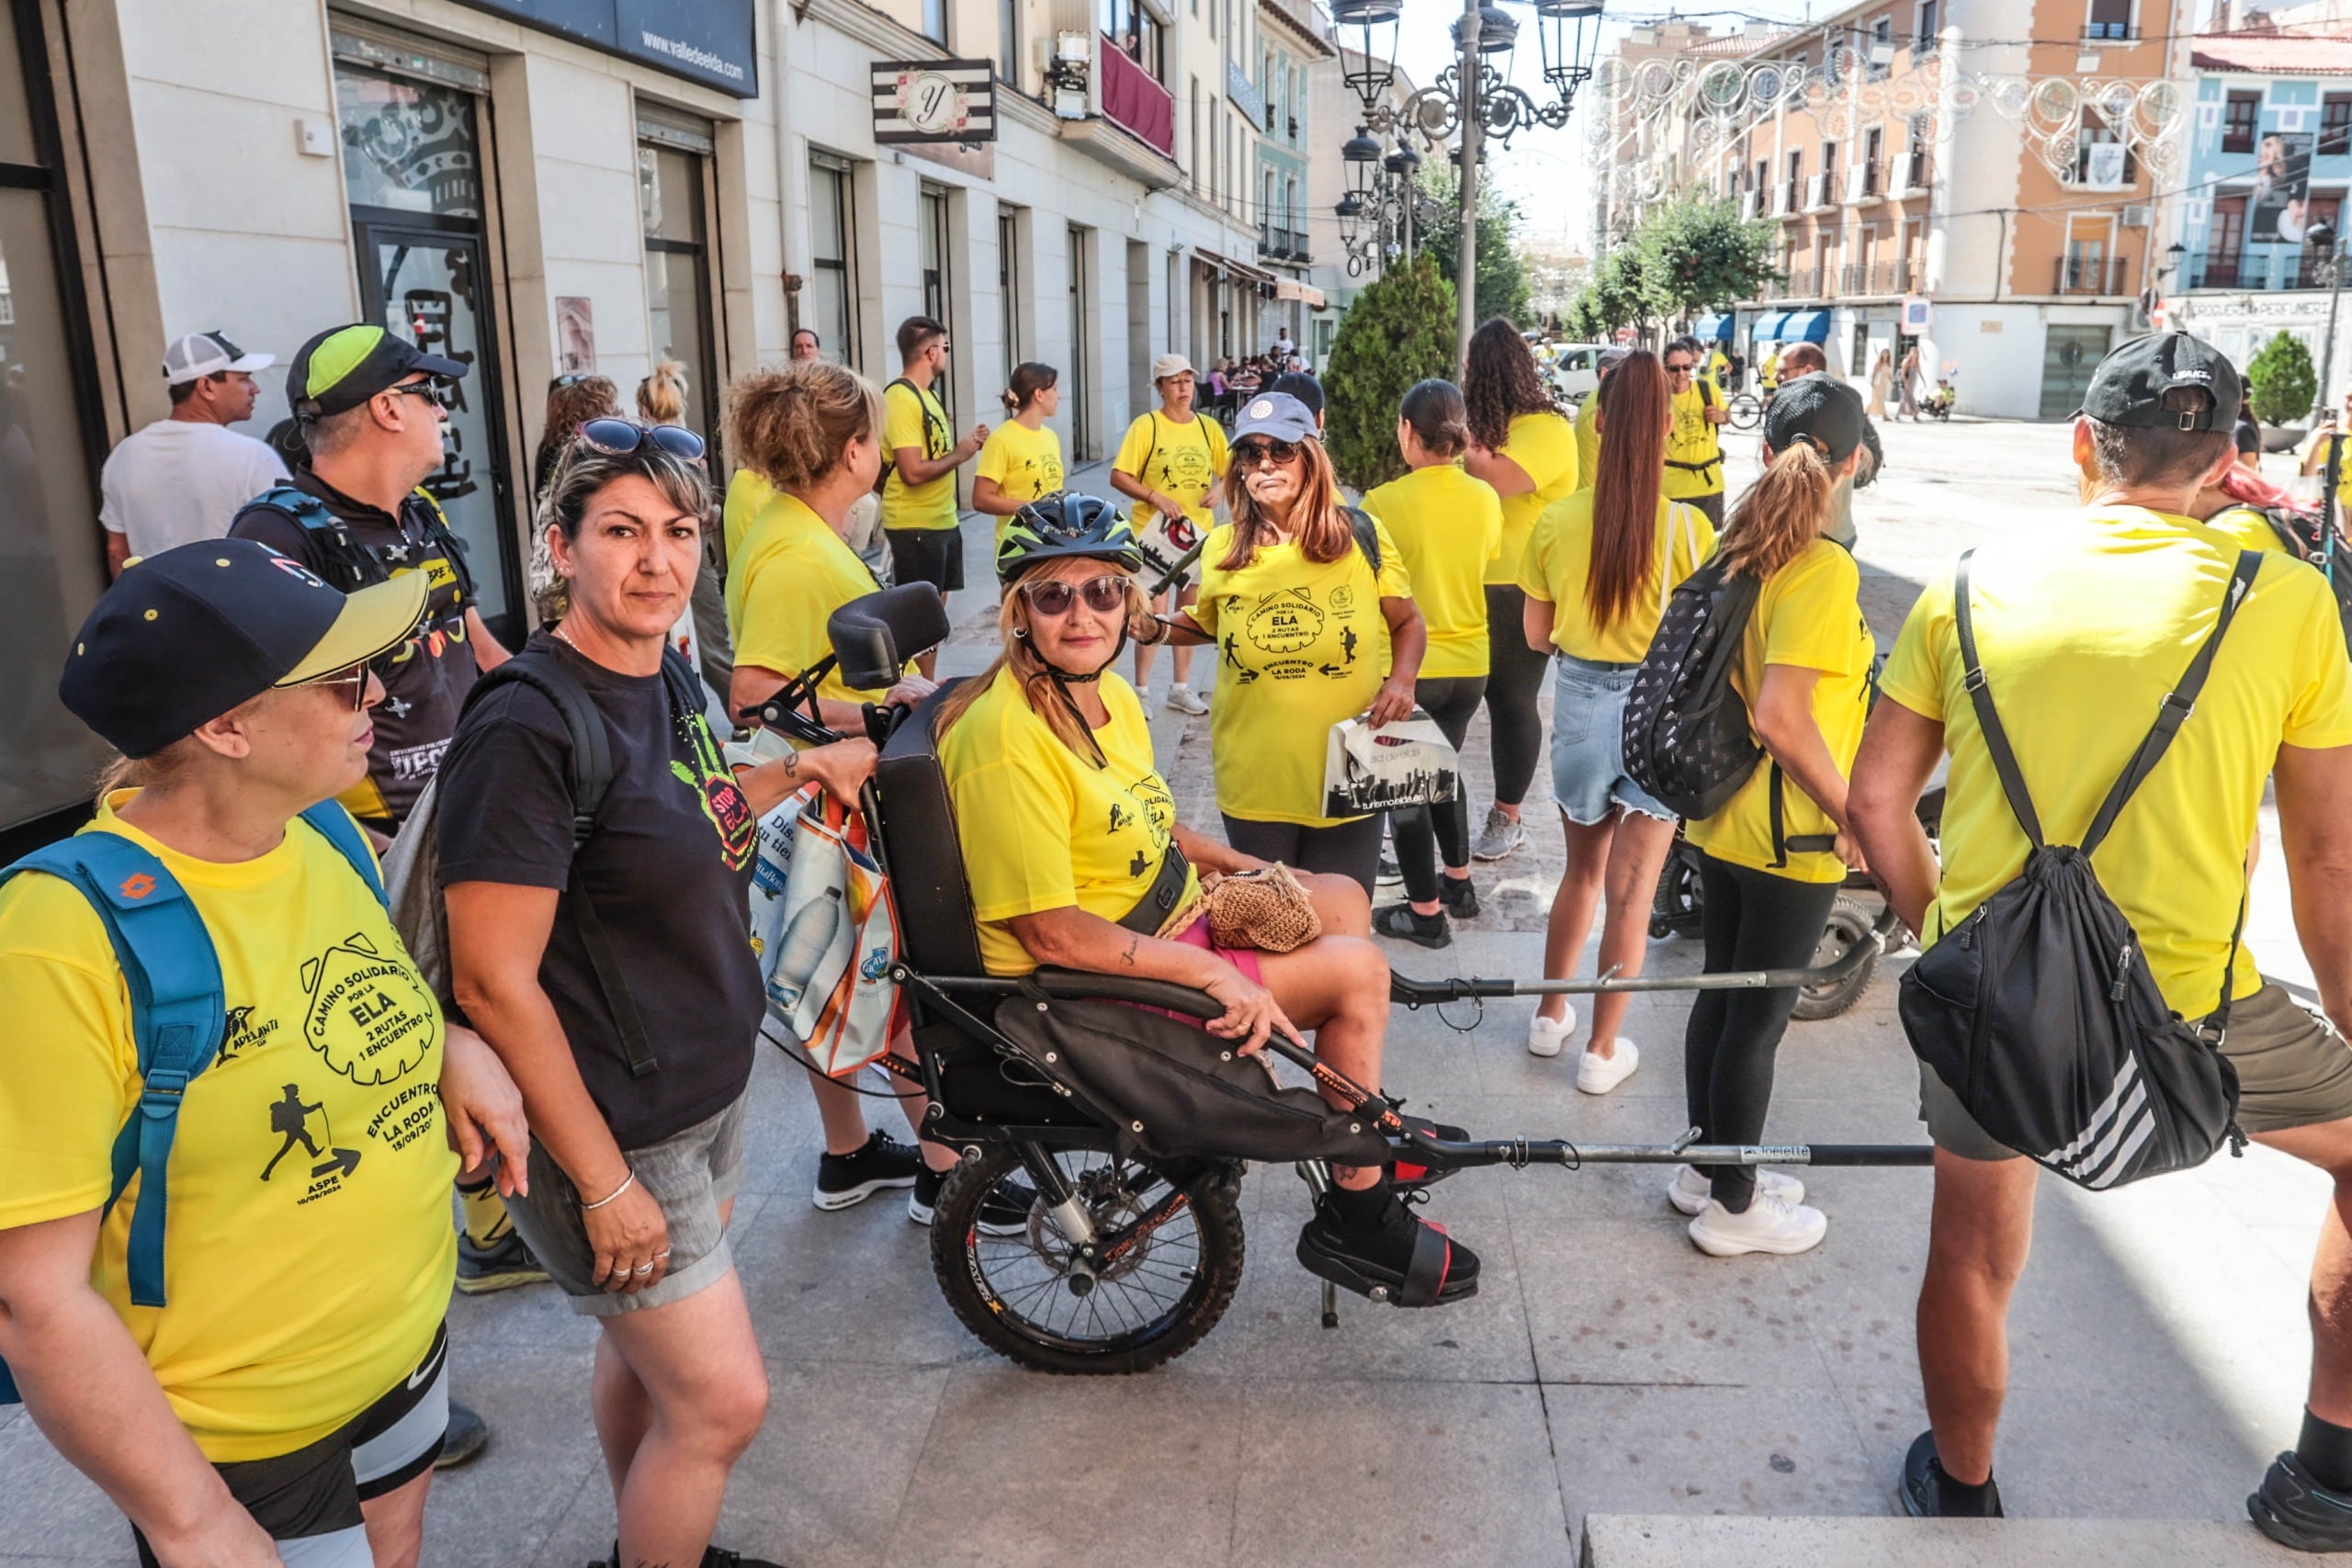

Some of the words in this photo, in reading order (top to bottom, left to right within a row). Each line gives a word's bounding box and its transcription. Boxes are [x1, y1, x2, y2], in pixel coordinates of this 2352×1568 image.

[642, 30, 743, 81] www.valledeelda.com
[1251, 604, 1279, 622] CAMINO
[1281, 603, 1321, 617] SOLIDARIO
[1272, 615, 1298, 626] ELA
[1267, 631, 1309, 639] ENCUENTRO
[1262, 659, 1315, 671] ENCUENTRO
[711, 786, 737, 814] STOP
[1362, 793, 1425, 810] turismo.elda.es
[723, 802, 748, 831] ELA
[313, 984, 345, 1037] CAMINO
[345, 965, 410, 987] SOLIDARIO
[347, 991, 365, 1003] POR
[363, 984, 375, 994] LA
[349, 992, 397, 1027] ELA
[358, 1052, 366, 1061] 1
[366, 1014, 424, 1057] ENCUENTRO
[366, 1032, 375, 1042] 2
[374, 1010, 408, 1036] RUTAS
[367, 1083, 439, 1138] ENCUENTRO
[382, 1124, 403, 1142] LA
[402, 1100, 435, 1131] RODA
[391, 1118, 432, 1152] 15/09/20
[308, 1175, 339, 1194] ASPE
